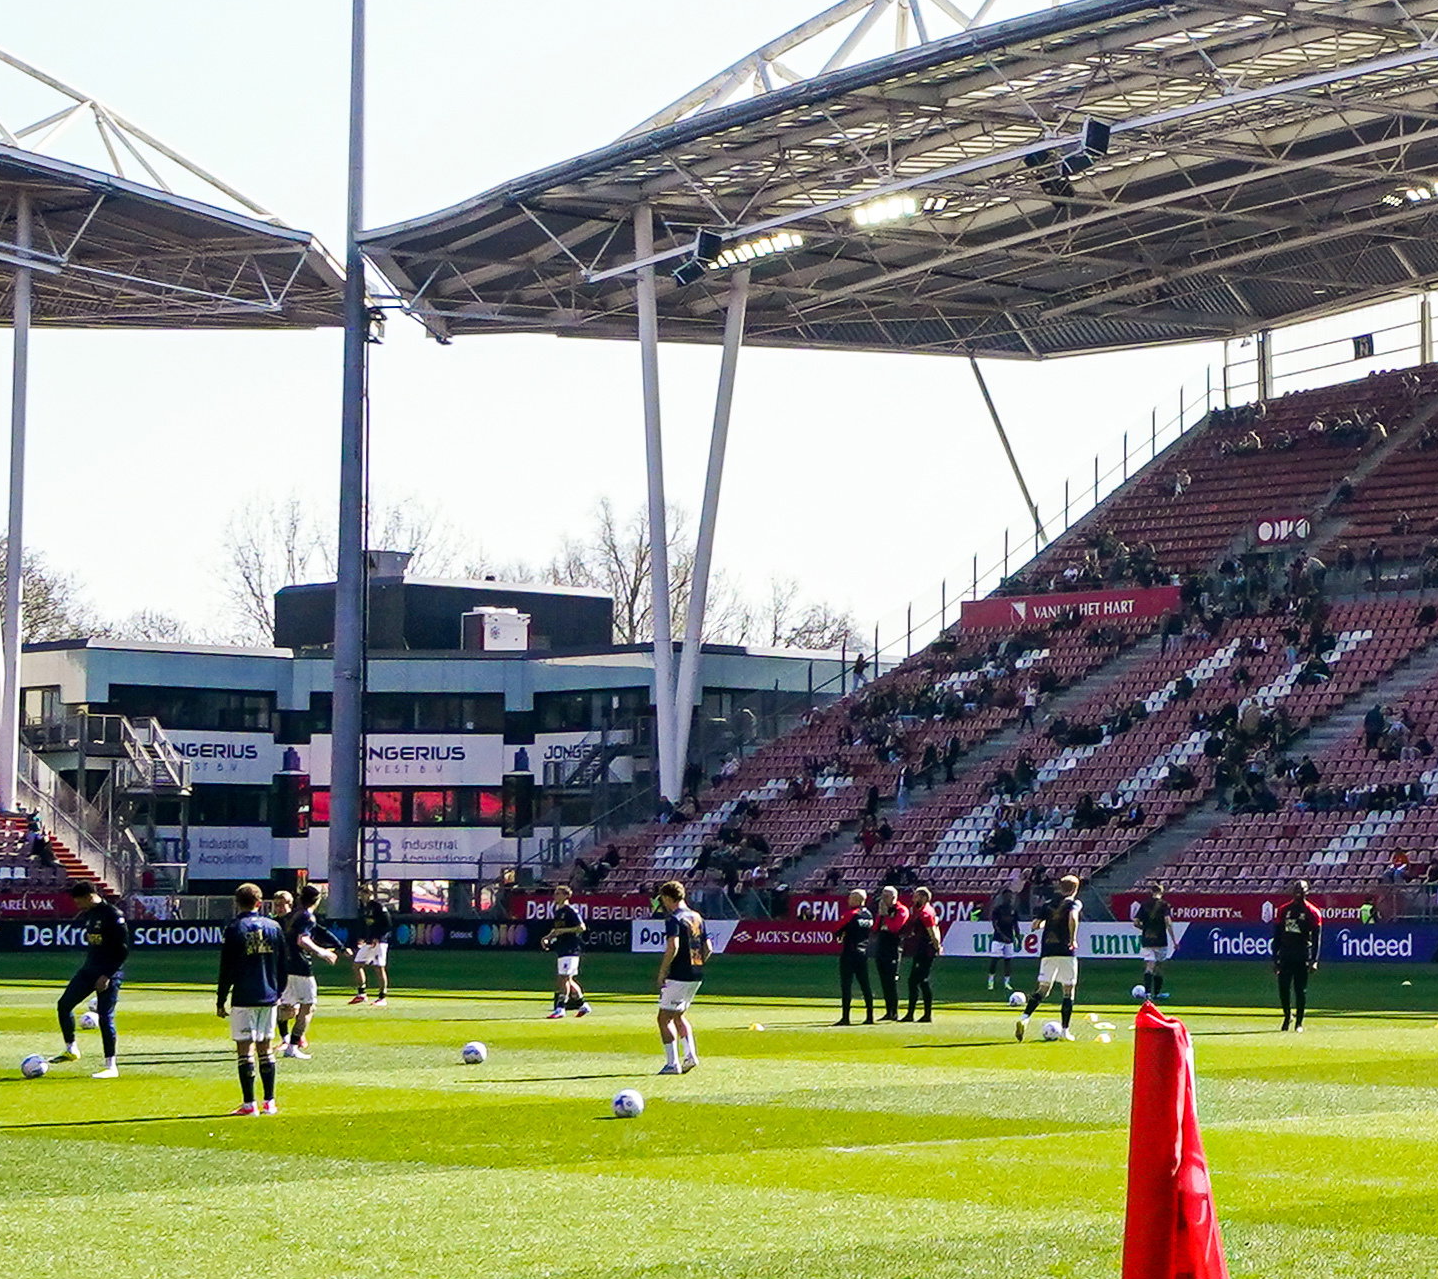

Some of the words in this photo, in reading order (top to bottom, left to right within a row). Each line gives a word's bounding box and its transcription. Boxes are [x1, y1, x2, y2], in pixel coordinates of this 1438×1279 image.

[1080, 603, 1102, 617] HET
[1104, 599, 1135, 615] HART
[171, 743, 258, 760] NGERIUS
[31, 899, 55, 911] VAK
[592, 906, 653, 922] BEVEILIGIN
[23, 924, 53, 947] De
[755, 930, 790, 943] JACK'S
[792, 930, 833, 944] CASINO
[1338, 928, 1413, 957] indeed
[1090, 934, 1143, 955] univ
